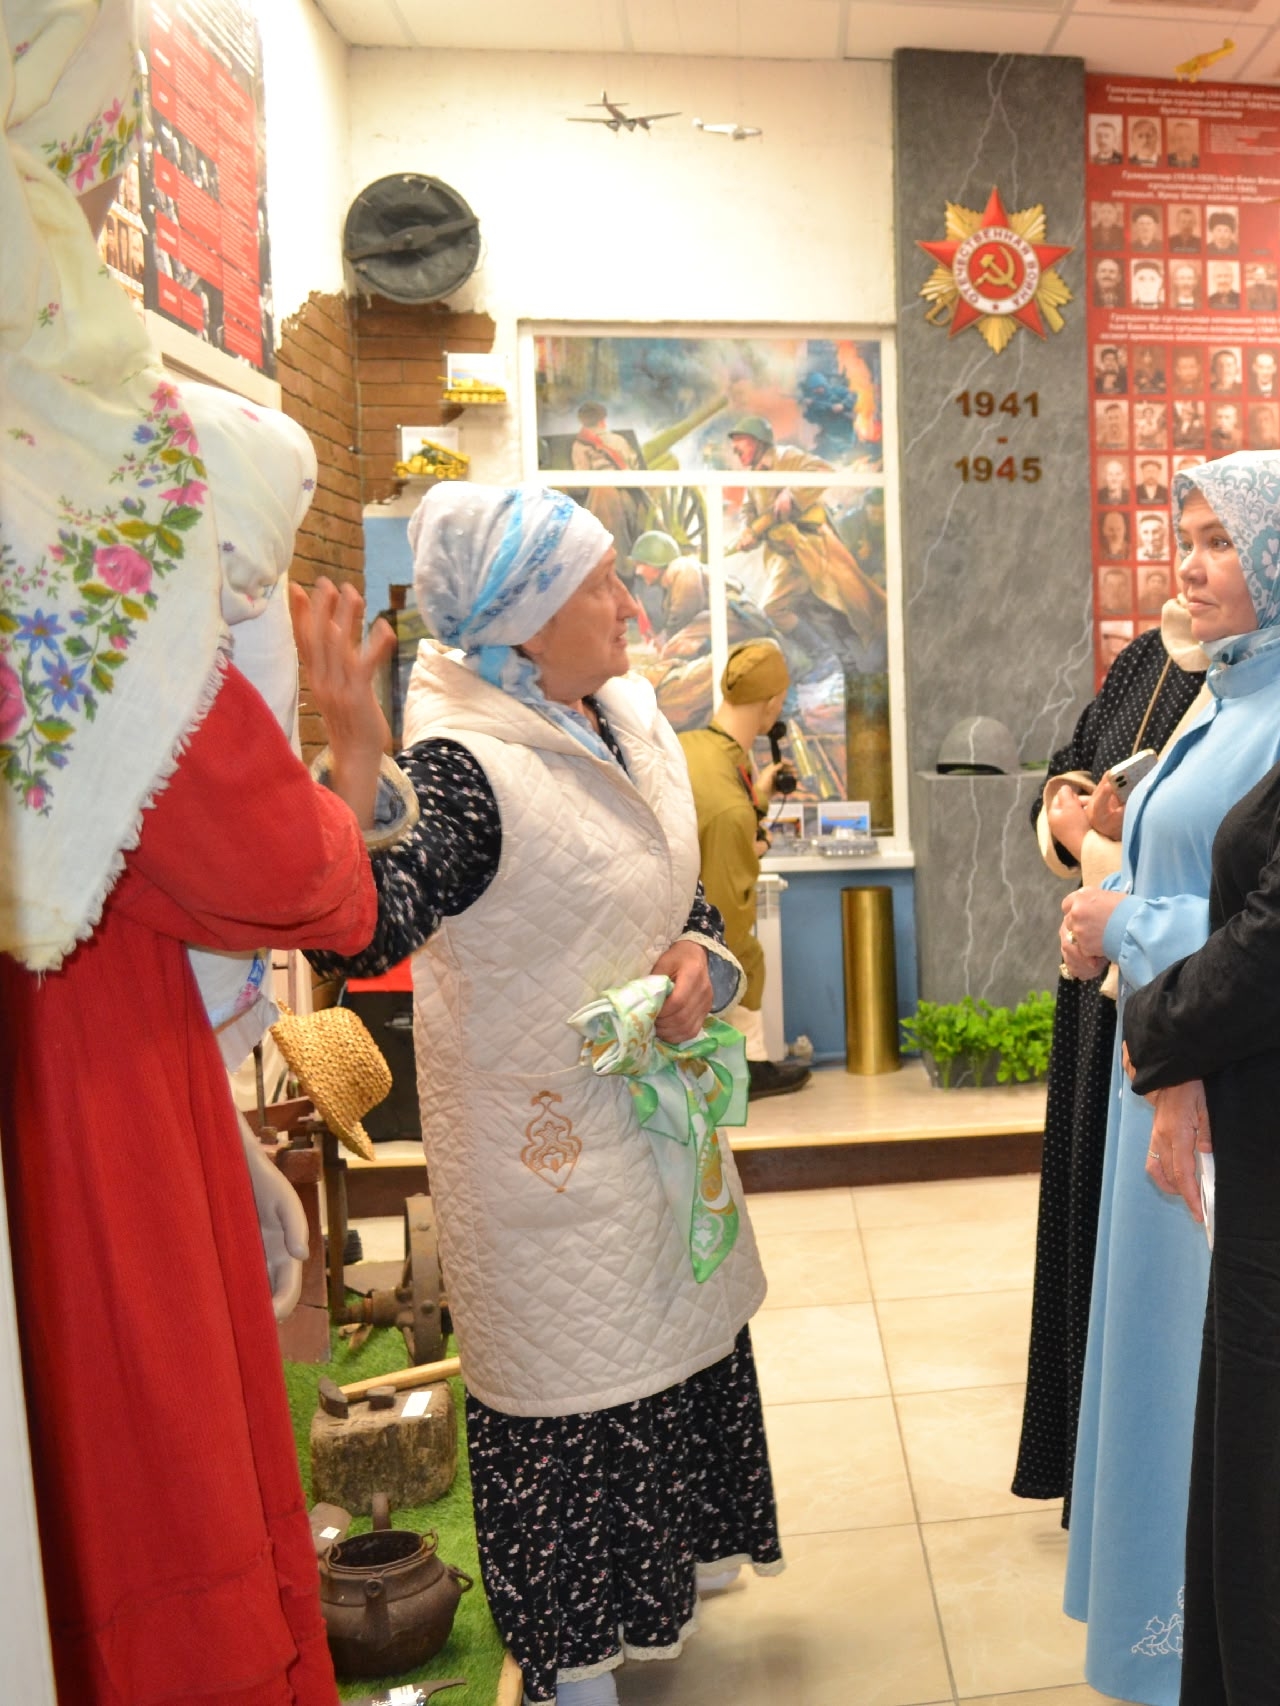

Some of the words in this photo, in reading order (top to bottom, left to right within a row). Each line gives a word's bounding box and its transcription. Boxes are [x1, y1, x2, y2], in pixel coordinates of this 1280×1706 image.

[956, 229, 1030, 303] ОТЕЧЕСТВЕННАЯ
[1011, 261, 1037, 306] ВОЙНА
[955, 390, 1039, 418] 1941
[954, 456, 1043, 484] 1945
